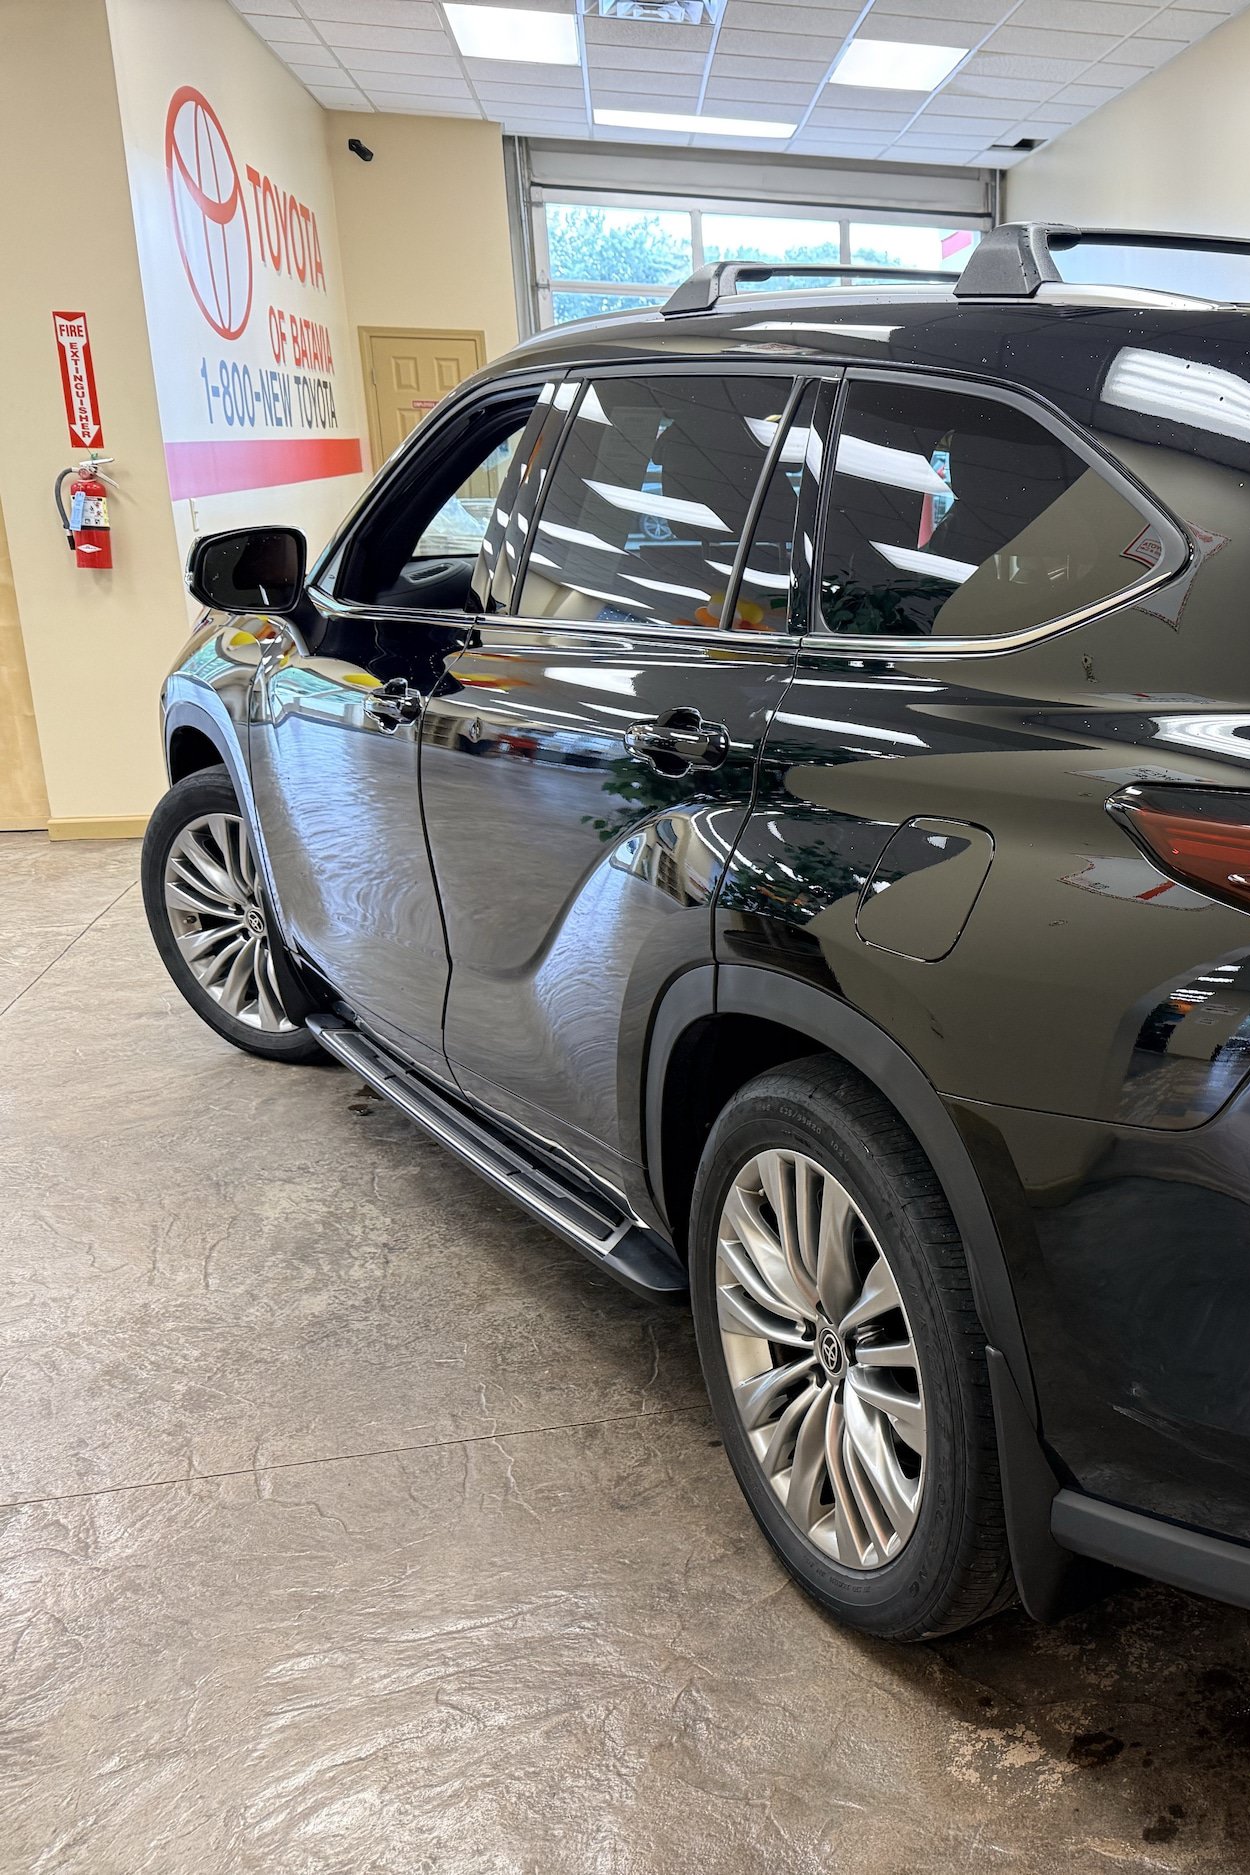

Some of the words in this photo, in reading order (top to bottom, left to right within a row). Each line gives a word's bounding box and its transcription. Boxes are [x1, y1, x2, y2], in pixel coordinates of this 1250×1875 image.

[246, 164, 327, 294] TOYOTA
[59, 324, 84, 338] FIRE
[268, 305, 287, 366] OF
[289, 313, 335, 376] BATAVIA
[69, 342, 91, 438] EXTINGUISHER
[200, 356, 293, 428] 1-800-NEW
[293, 375, 339, 430] TOYOTA
